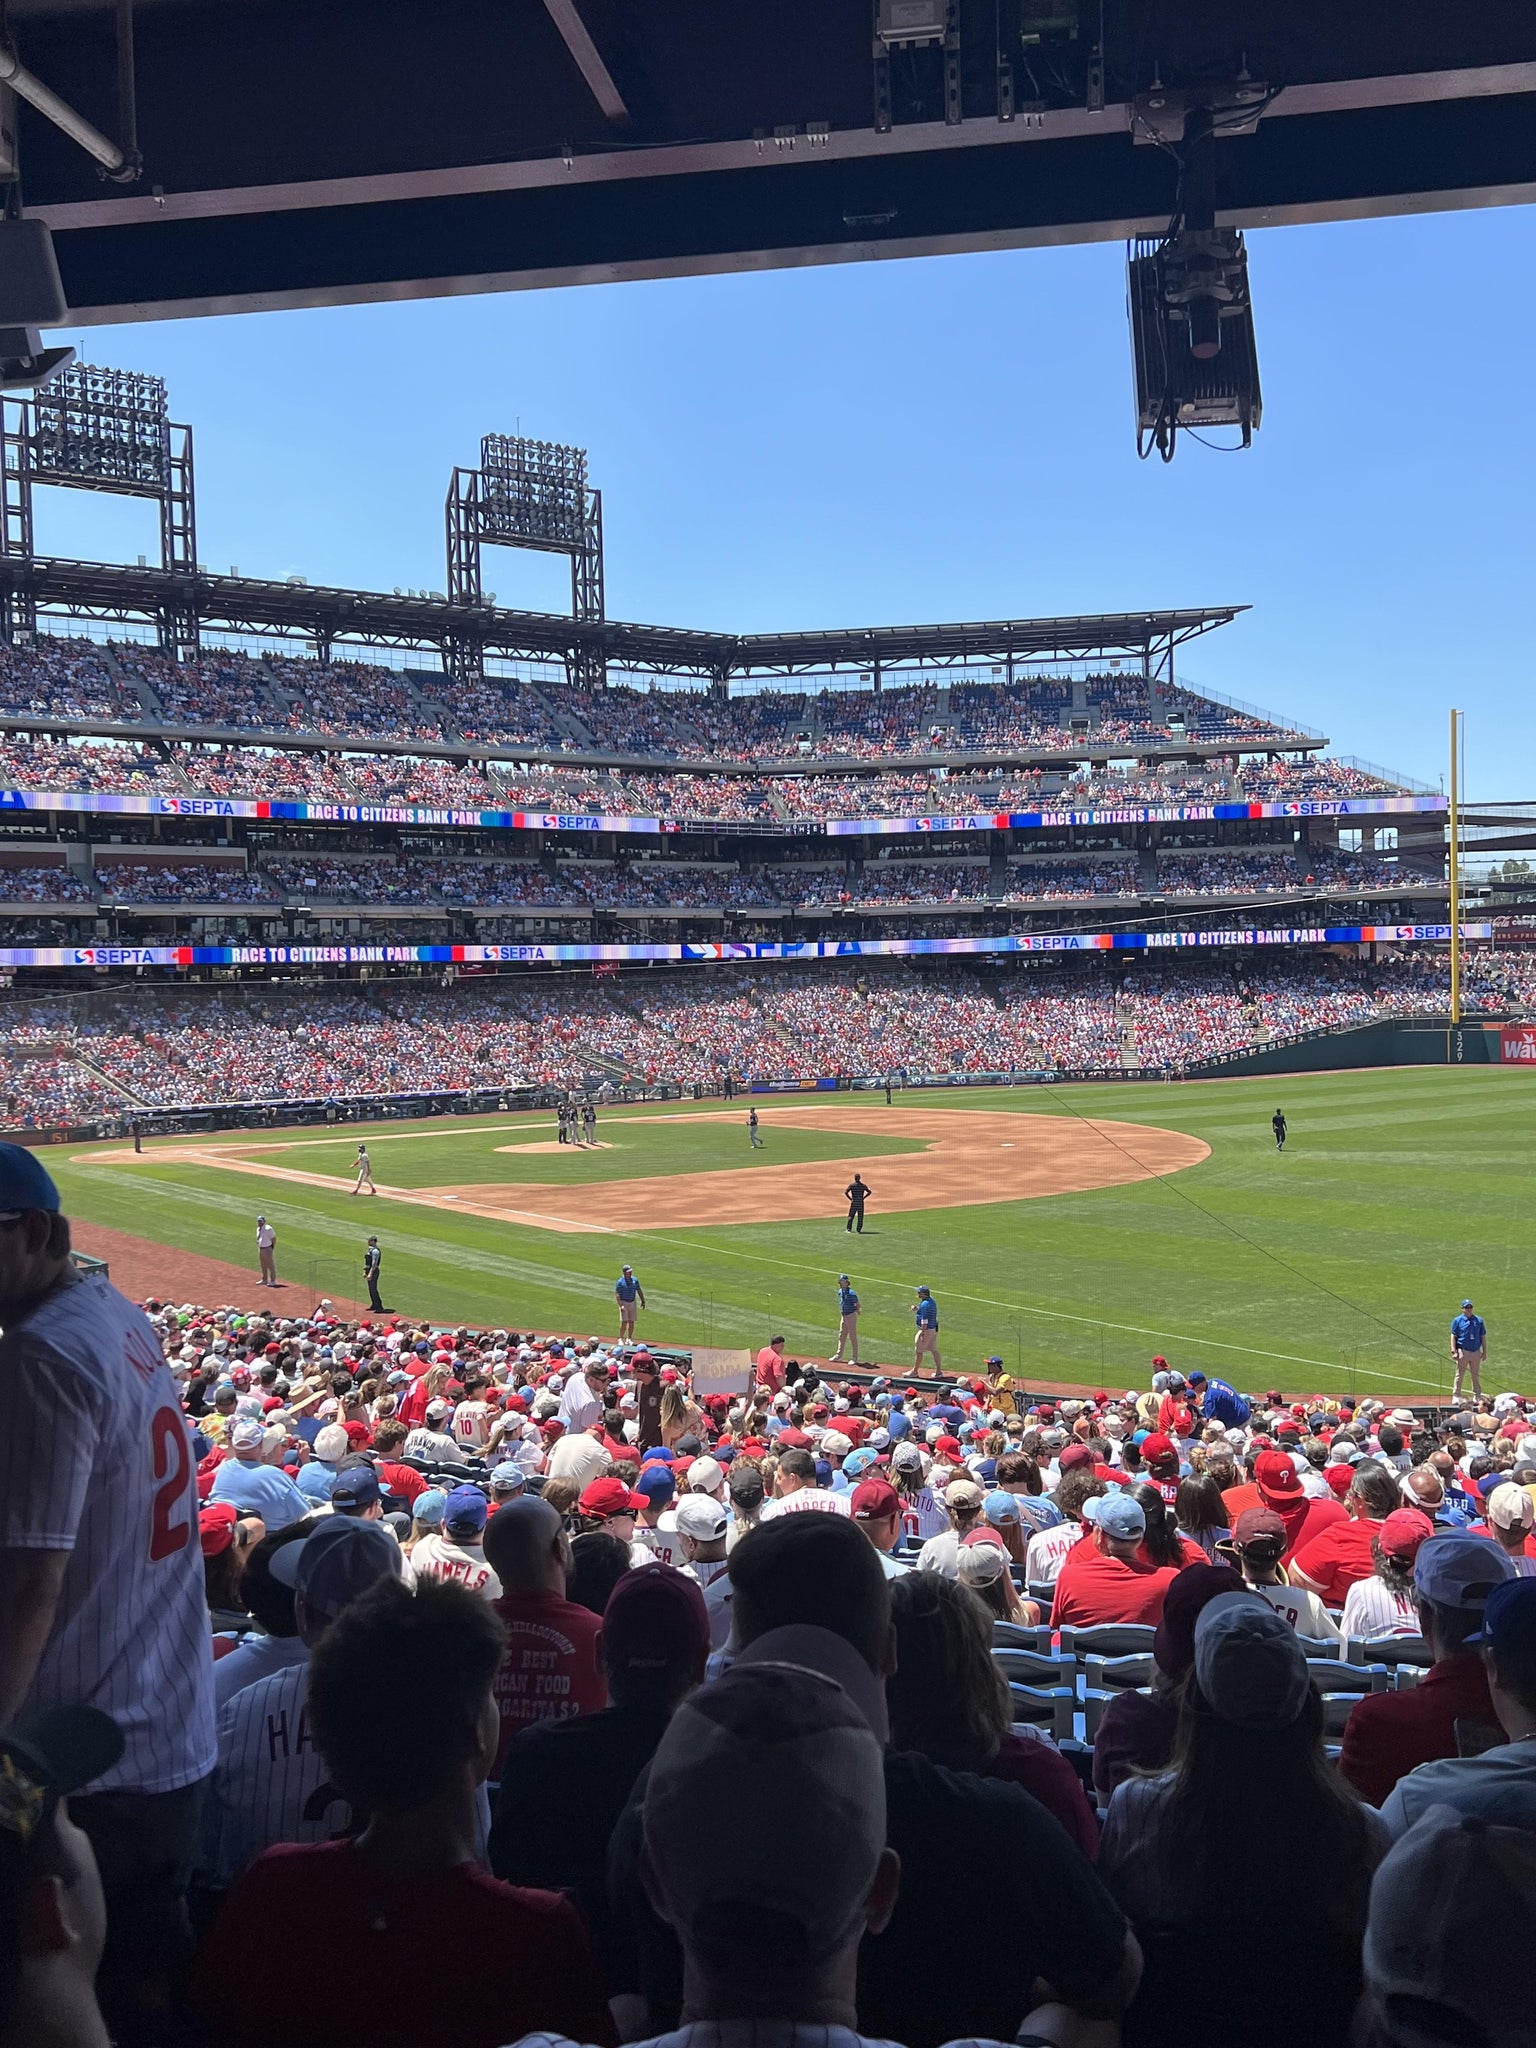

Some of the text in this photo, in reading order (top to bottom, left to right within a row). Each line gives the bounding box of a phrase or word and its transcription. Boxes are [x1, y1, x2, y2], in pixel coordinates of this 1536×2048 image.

[180, 799, 234, 815] SEPTA
[306, 804, 482, 826] RACE TO CITIZENS BANK PARK
[1300, 802, 1349, 815] SEPTA
[558, 816, 600, 829] SEPTA
[931, 817, 977, 830] SEPTA
[1042, 806, 1215, 826] RACE TO CITIZENS BANK PARK
[1146, 928, 1326, 947] RACE TO CITIZENS BANK PARK
[1414, 926, 1465, 939] SEPTA
[1032, 937, 1079, 949] SEPTA
[96, 949, 154, 964] SEPTA
[231, 946, 419, 962] RACE TO CITIZENS BANK PARK
[500, 947, 544, 959] SEPTA
[461, 1419, 473, 1436] 10
[411, 1435, 437, 1452] FRANCO
[149, 1405, 191, 1562] 2
[520, 1648, 558, 1669] BEST
[535, 1674, 571, 1695] FOOD
